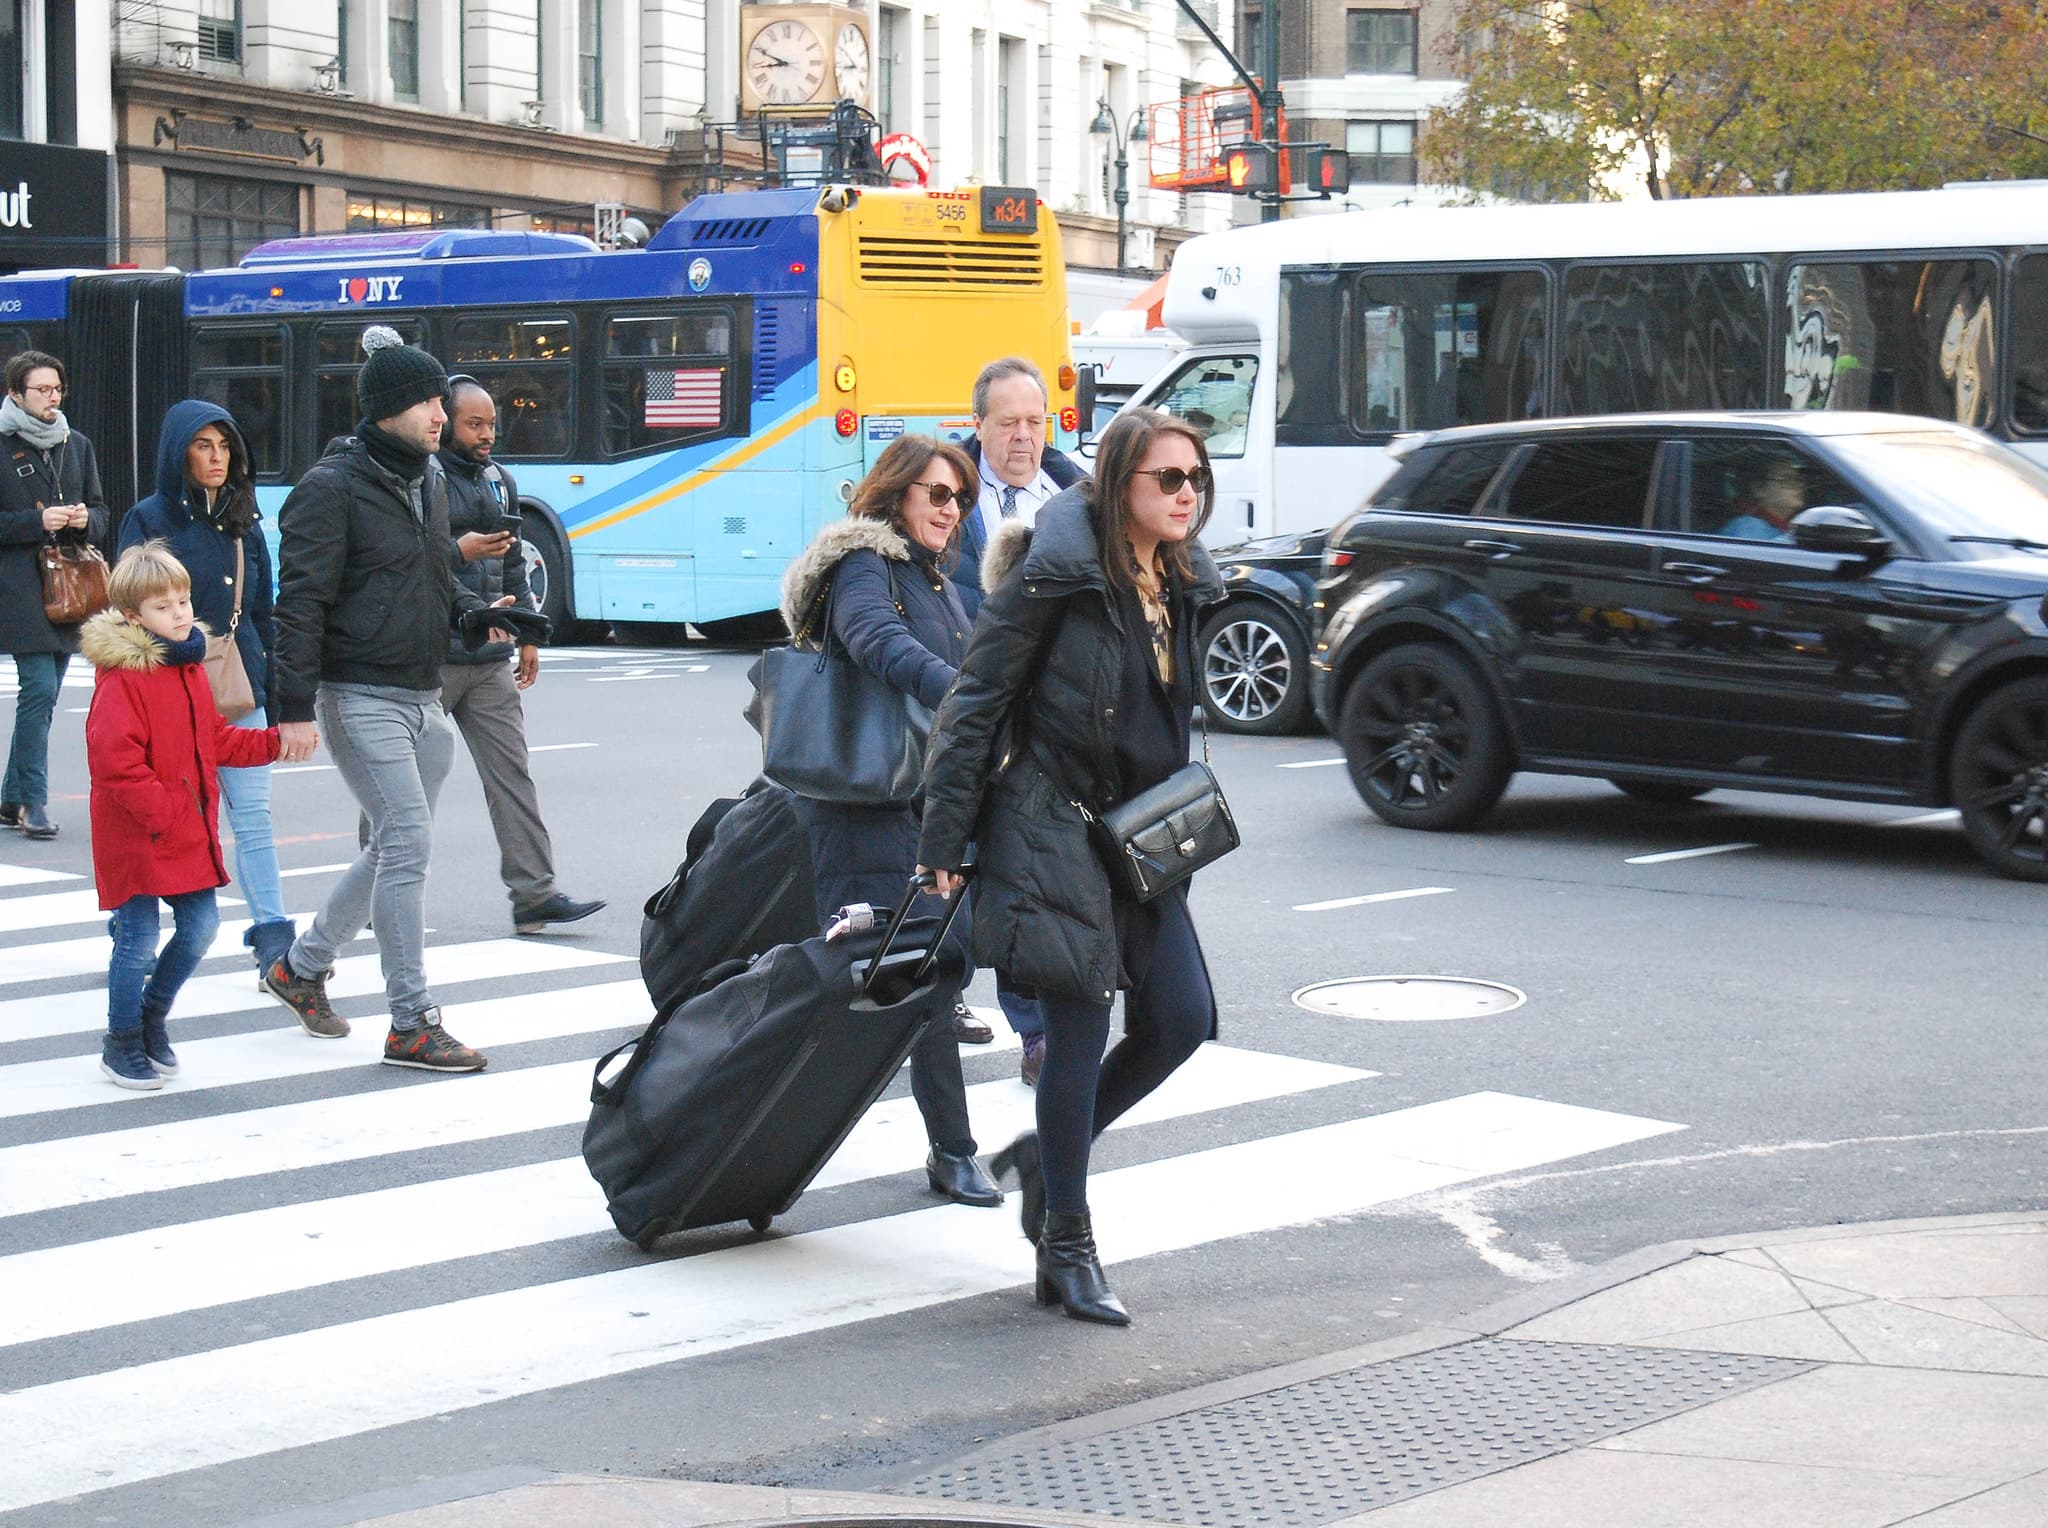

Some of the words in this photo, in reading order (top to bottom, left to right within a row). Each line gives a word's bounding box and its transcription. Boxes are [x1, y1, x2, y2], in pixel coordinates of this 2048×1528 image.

[936, 204, 966, 221] 5456
[1217, 266, 1241, 286] 763
[338, 278, 350, 304] I
